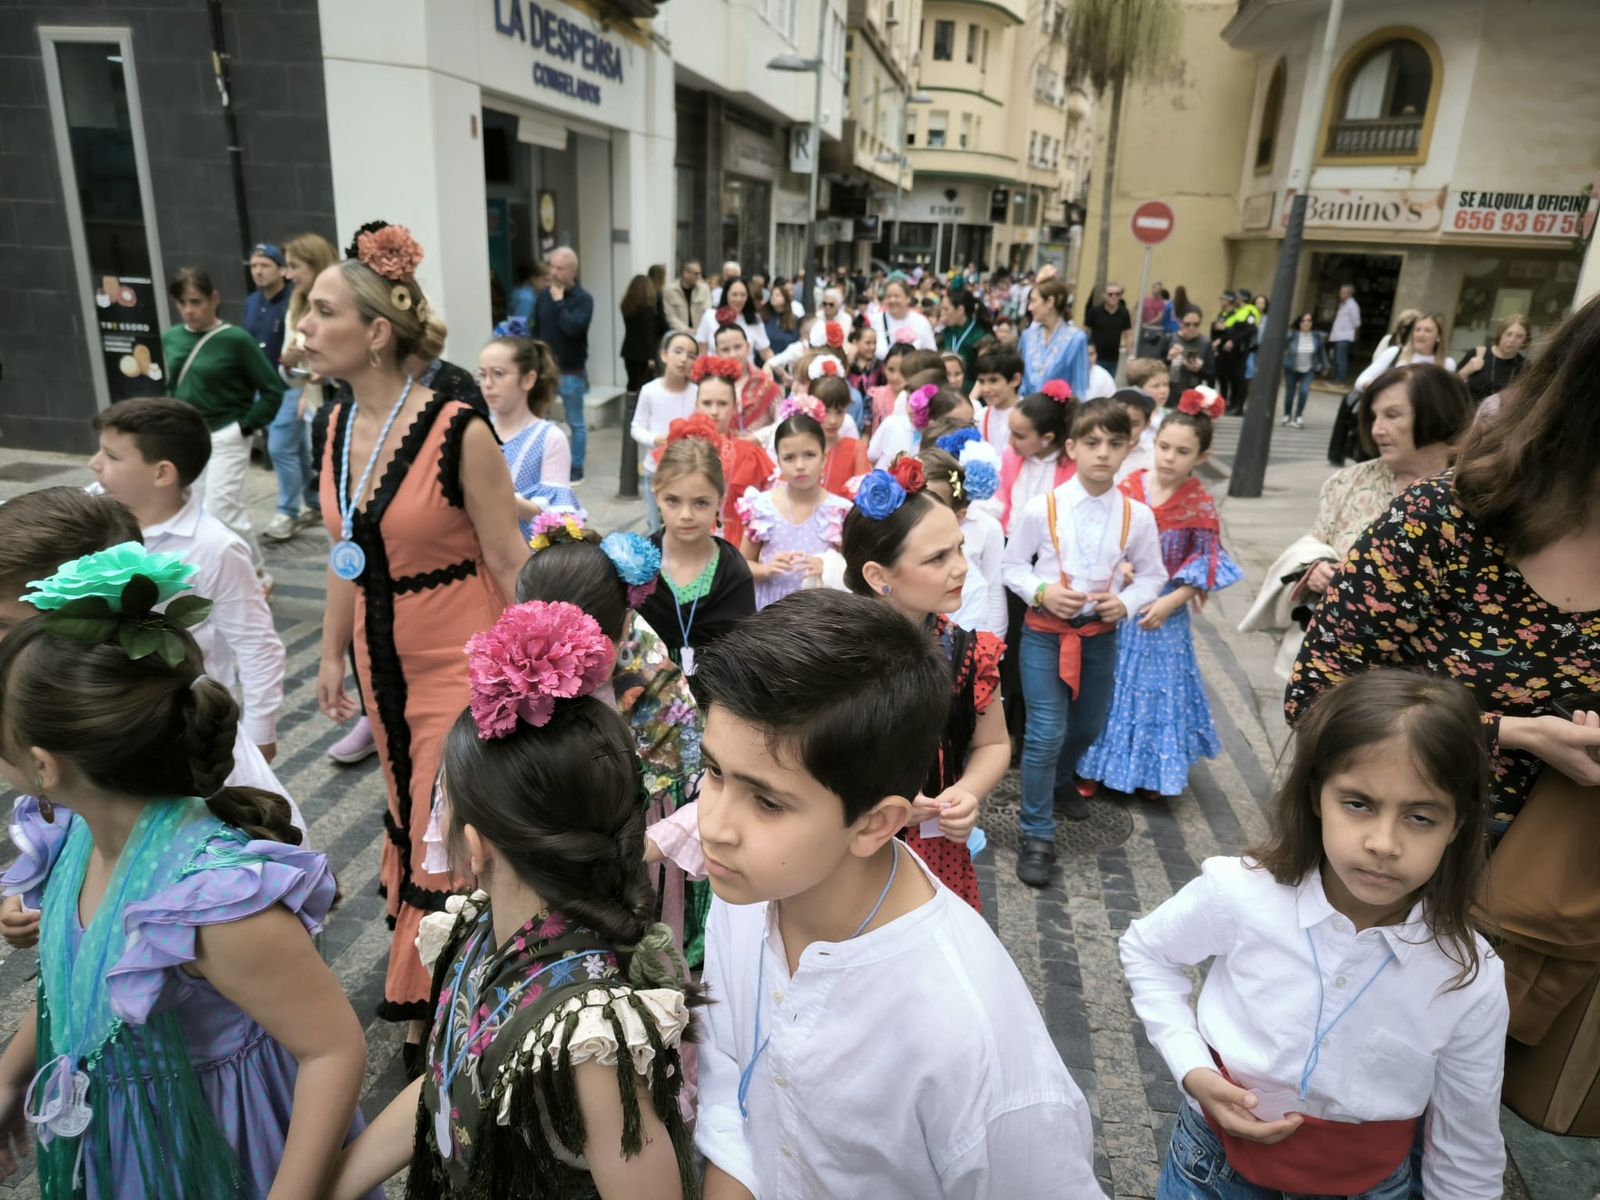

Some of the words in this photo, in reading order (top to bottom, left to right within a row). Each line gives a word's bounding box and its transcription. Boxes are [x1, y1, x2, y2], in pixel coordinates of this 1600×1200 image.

[494, 0, 526, 43] LA
[529, 1, 624, 85] DESPENSA
[533, 61, 601, 106] CONGELADOS
[795, 129, 809, 159] R
[1459, 191, 1476, 208] SE
[1477, 191, 1534, 211] ALQUILA
[1454, 210, 1496, 231] 656
[1501, 211, 1528, 232] 93
[1532, 213, 1558, 234] 67
